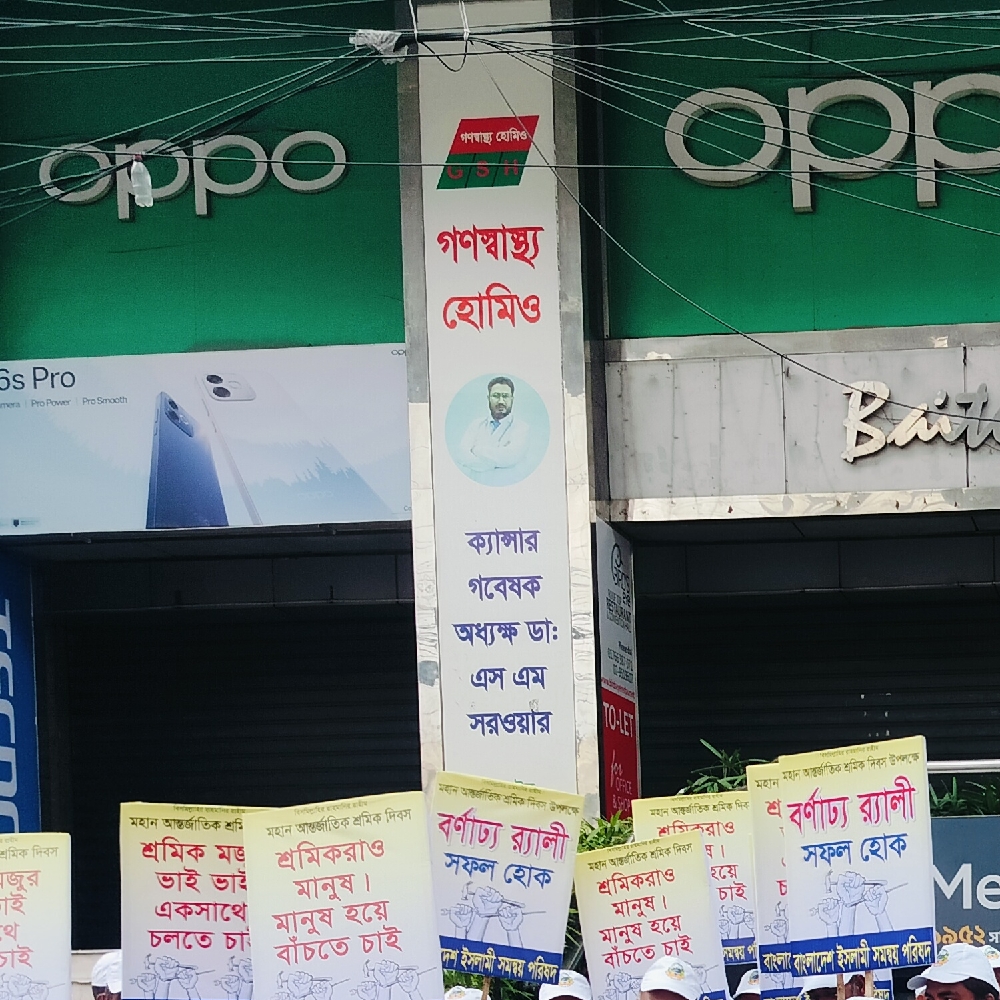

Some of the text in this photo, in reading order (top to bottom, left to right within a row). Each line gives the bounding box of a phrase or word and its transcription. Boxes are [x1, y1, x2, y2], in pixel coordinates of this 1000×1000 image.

[38, 130, 347, 221] oppo
[436, 223, 546, 269] গণস্বাস্থ্য
[442, 283, 543, 332] হোমিও
[32, 366, 76, 389] Pro
[465, 528, 541, 555] ক্যান্সার
[468, 574, 543, 601] গবেষক
[451, 621, 521, 647] অধ্যক্ষ
[470, 666, 547, 692] এস এম
[467, 710, 553, 737] সরওয়ার
[602, 701, 634, 738] TO-LET
[140, 836, 207, 864] শ্রমিক
[275, 839, 385, 871] শ্রমিকরাও
[801, 833, 908, 868] সফল হোক
[154, 866, 202, 893] ভাই
[444, 852, 555, 889] সফল হোক
[597, 868, 675, 896] শ্রমিকরাও
[716, 882, 748, 902] চাই
[155, 901, 248, 923] একসাথে
[271, 907, 334, 936] মানুষ
[147, 929, 215, 951] চলতে
[358, 924, 403, 953] চাই
[599, 921, 642, 945] মানুষ
[661, 934, 693, 956] চাই
